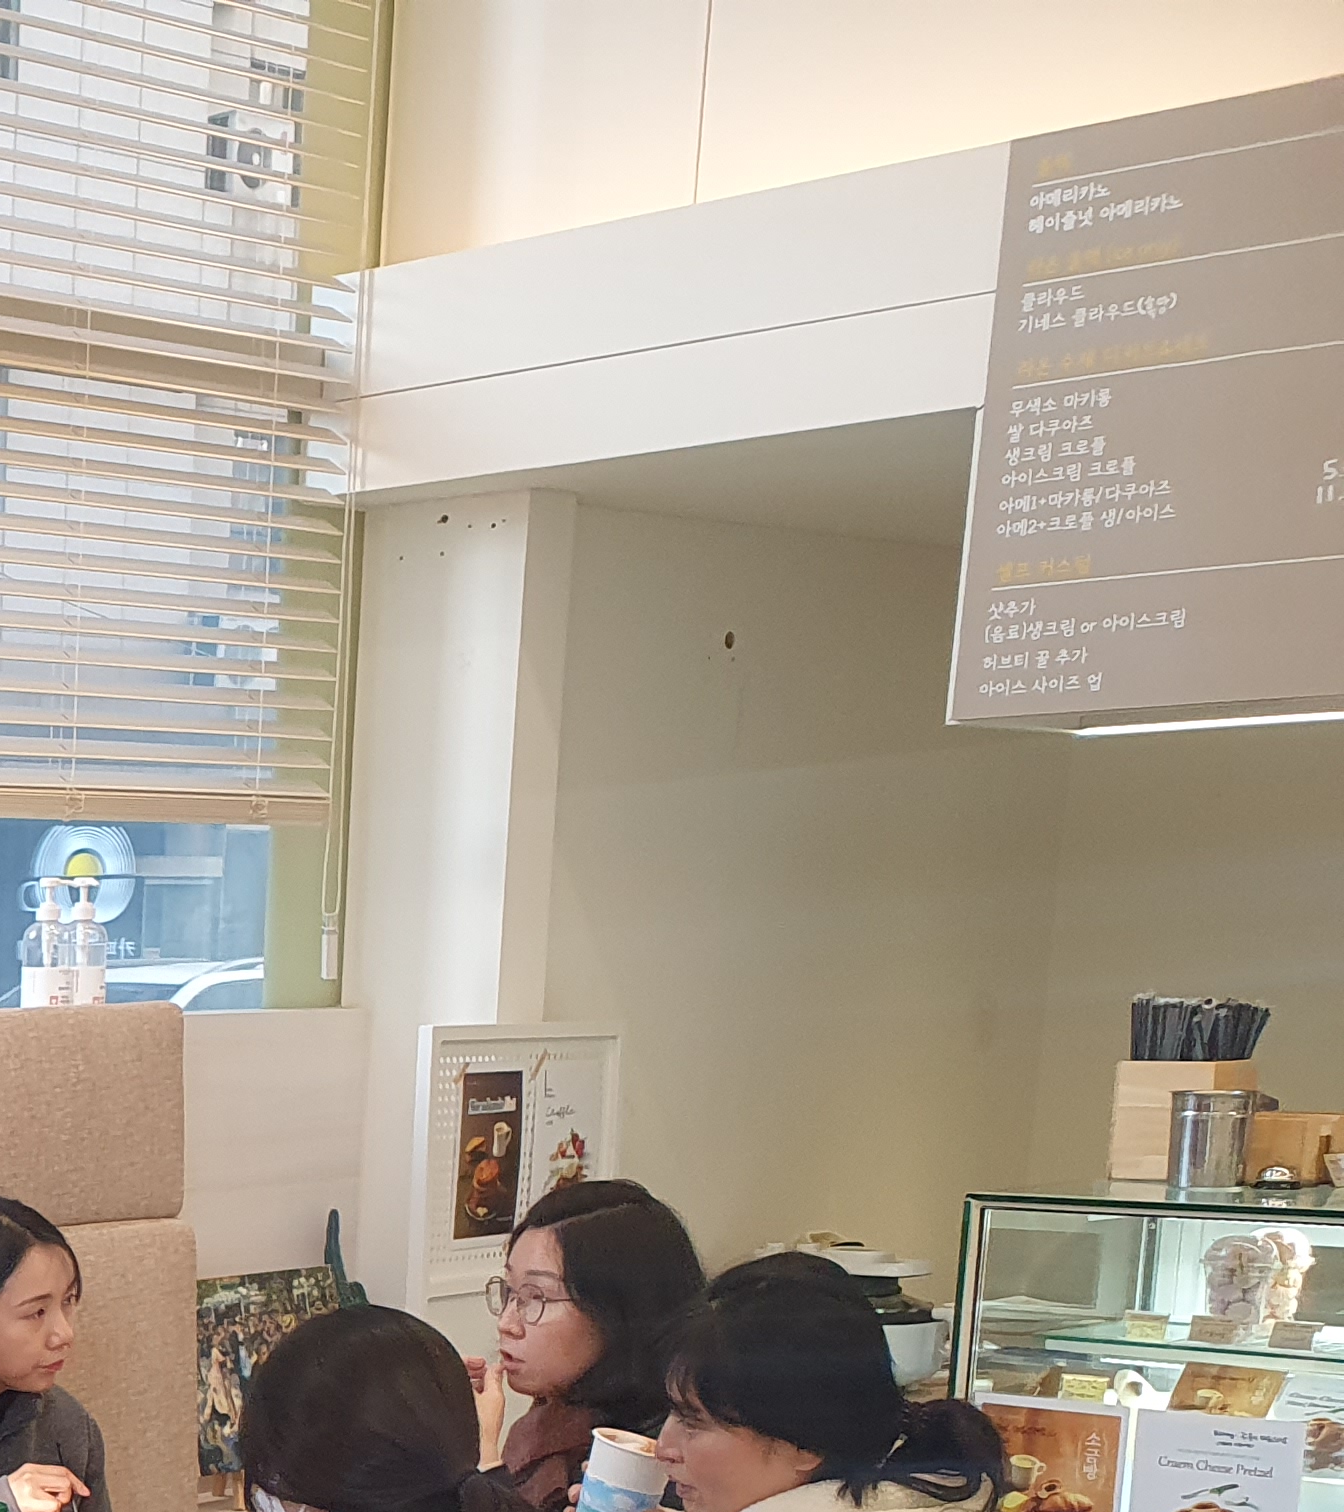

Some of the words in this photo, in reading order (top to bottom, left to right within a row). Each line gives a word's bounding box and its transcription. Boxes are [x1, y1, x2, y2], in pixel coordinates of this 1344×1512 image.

[1030, 182, 1111, 210] 아메리카노
[1099, 193, 1184, 222] 아메리카노
[1021, 285, 1086, 312] 클라우드
[1018, 313, 1067, 334] 기네스
[1009, 396, 1057, 418] 무색소
[1007, 422, 1024, 444] 쌀
[1029, 415, 1094, 438] 다쿠아즈
[1004, 442, 1053, 467] 생크림
[1057, 436, 1107, 457] 크로플
[1002, 462, 1082, 489] 아이스크림
[1087, 455, 1136, 477] 크로플
[1315, 484, 1344, 505] 11
[996, 512, 1095, 538] 아메2+크로플
[1099, 503, 1177, 528] 생/아이스
[987, 597, 1037, 621] 샷추가
[1080, 621, 1098, 635] or
[1102, 608, 1187, 634] 아이스크림
[982, 651, 1030, 671] 허브티
[1034, 650, 1050, 669] 꿀
[1055, 646, 1088, 665] 추가
[979, 679, 1028, 698] 아이스
[1031, 675, 1081, 694] 사이즈
[1086, 672, 1103, 693] 업
